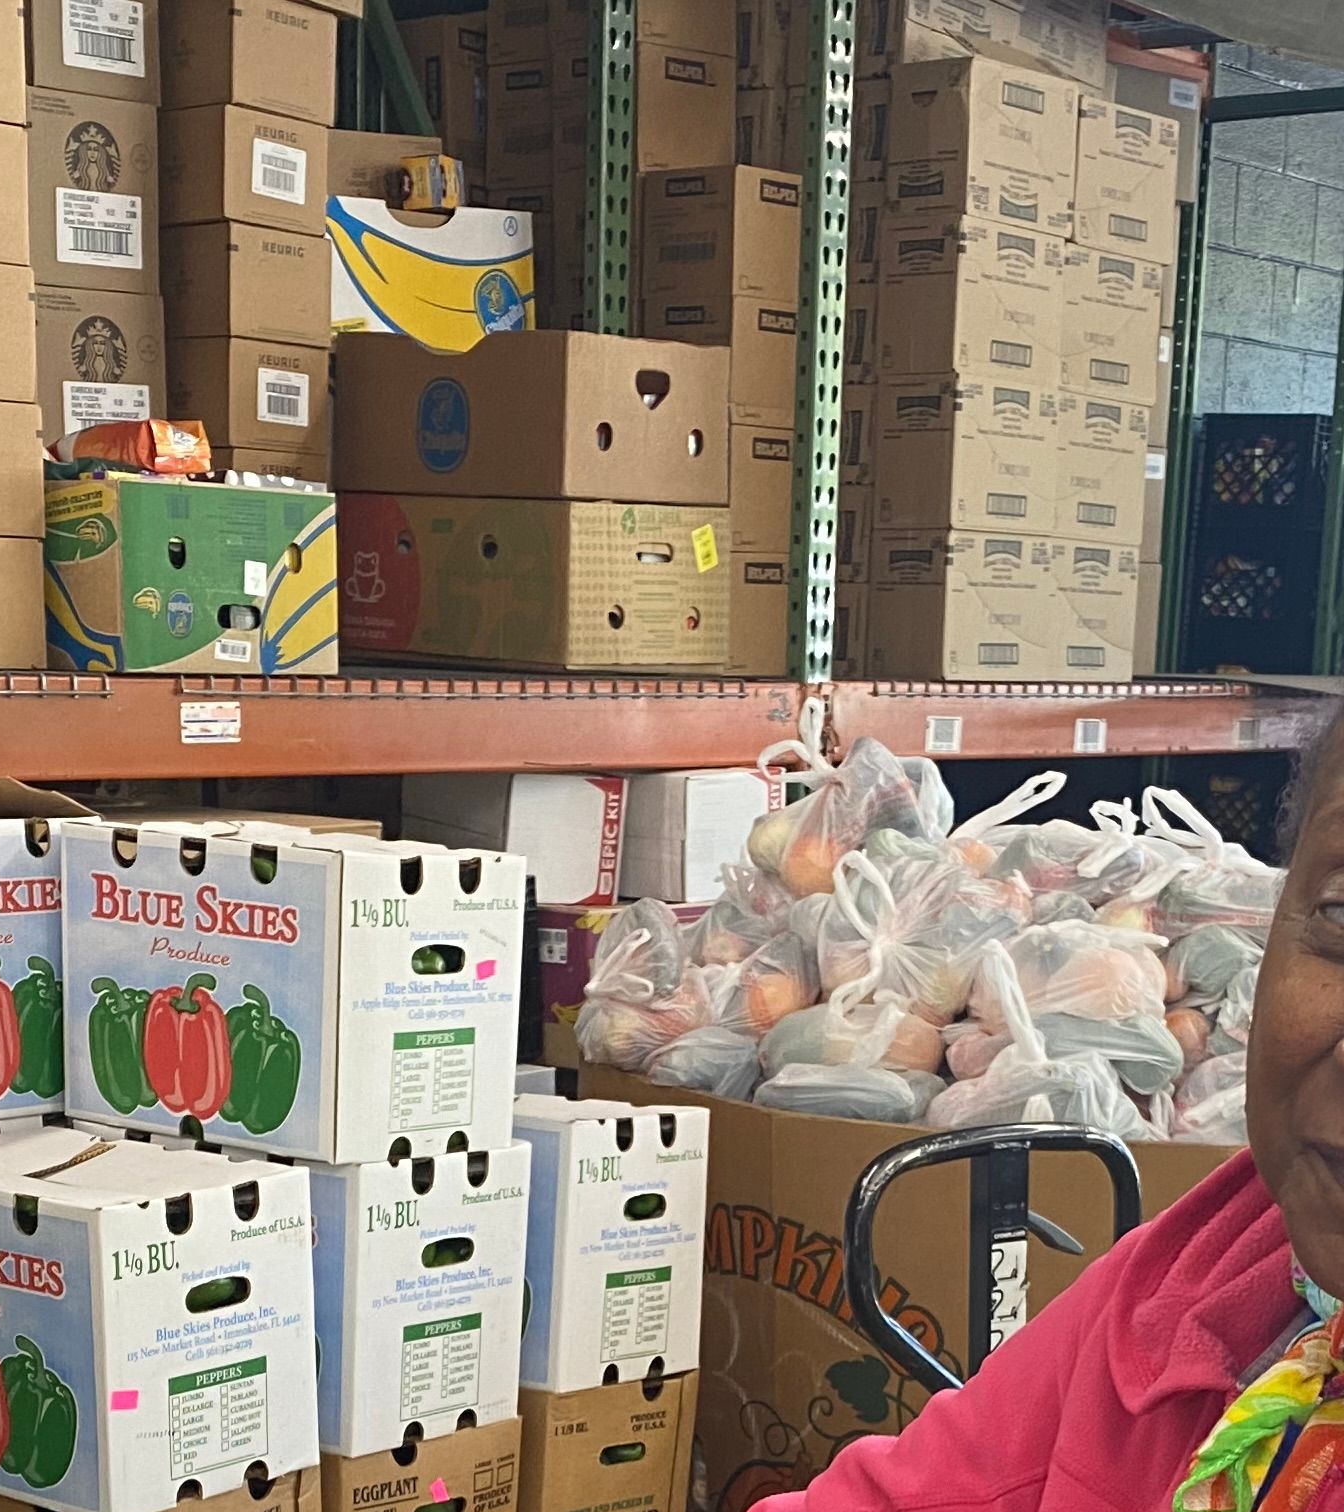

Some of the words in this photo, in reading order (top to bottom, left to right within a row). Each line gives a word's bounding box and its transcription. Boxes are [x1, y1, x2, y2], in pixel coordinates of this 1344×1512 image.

[266, 9, 308, 30] KEURIG
[255, 125, 297, 143] KEURIG
[263, 241, 305, 258] KEURIG
[258, 354, 301, 368] KEURIG
[606, 792, 620, 820] KIT
[601, 823, 618, 869] EPIC
[383, 899, 409, 927] BU.
[151, 937, 230, 965] Produce
[601, 1156, 622, 1182] BU.
[462, 1193, 491, 1205] Produce
[394, 1200, 419, 1228] BU.
[231, 1226, 267, 1241] Produce
[269, 1220, 279, 1232] of
[147, 1241, 180, 1274] BU.
[156, 1328, 180, 1342] Blue
[184, 1322, 210, 1337] Skies
[259, 1306, 276, 1317] Inc.
[425, 1320, 461, 1336] PEPPERS
[141, 1347, 159, 1359] New
[162, 1340, 192, 1355] Market
[195, 1334, 215, 1346] Road
[196, 1366, 242, 1386] PEPPERS
[182, 1392, 204, 1403] JUMBO
[183, 1401, 213, 1415] EX-LARGE
[631, 1411, 666, 1423] PRODUCE
[183, 1415, 204, 1426] LARGE
[632, 1424, 643, 1432] OF
[183, 1438, 207, 1448] CHOICE
[231, 1437, 251, 1448] GREEN
[184, 1452, 197, 1460] RED
[353, 1477, 418, 1505] EGGPLANT
[474, 1485, 512, 1504] PRODUCE
[474, 1504, 485, 1512] OF
